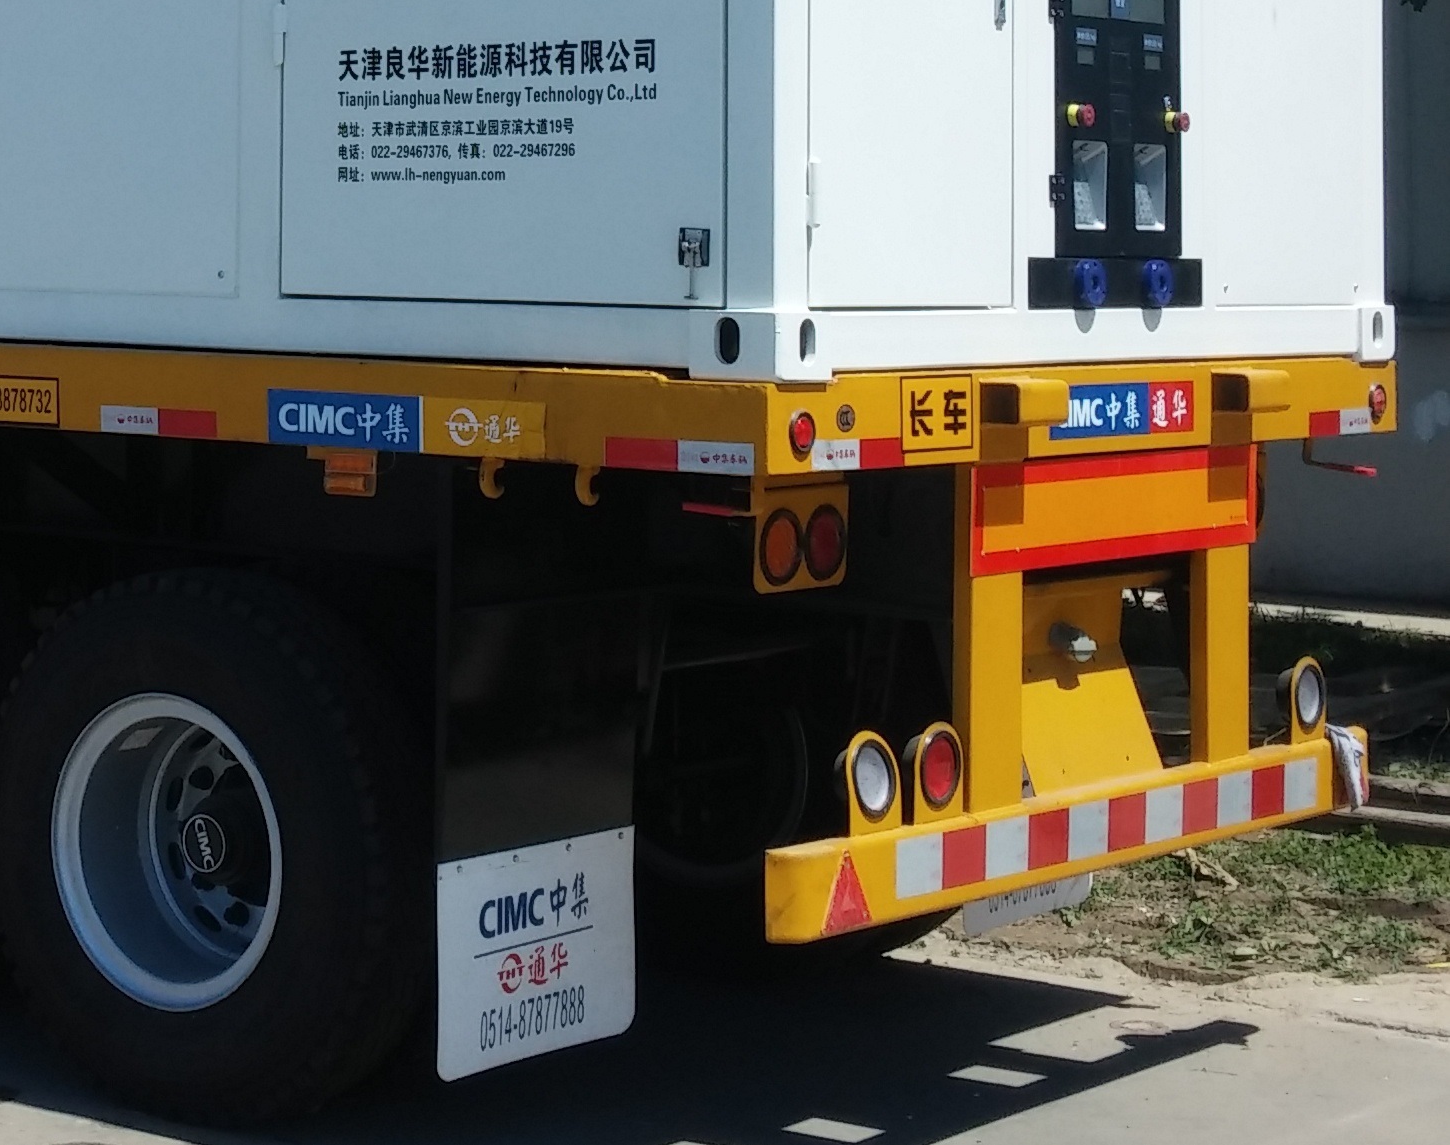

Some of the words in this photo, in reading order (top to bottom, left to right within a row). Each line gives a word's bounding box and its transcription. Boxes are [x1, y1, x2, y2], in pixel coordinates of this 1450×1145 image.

[338, 39, 656, 82] 天津良华新能源科技有限公司
[338, 91, 380, 110] Tianjin
[383, 90, 440, 109] Lianghua
[444, 89, 473, 105] New
[476, 87, 521, 107] Energy
[524, 85, 604, 105] Technology
[607, 83, 657, 102] Co.,Ltd
[484, 414, 521, 444] 通华
[910, 389, 967, 437] 长车
[1060, 390, 1141, 430] IMC中集
[1152, 389, 1187, 428] 通华
[195, 819, 215, 869] CIMC
[528, 942, 568, 986] 通华
[480, 985, 585, 1052] 0514-87877888
